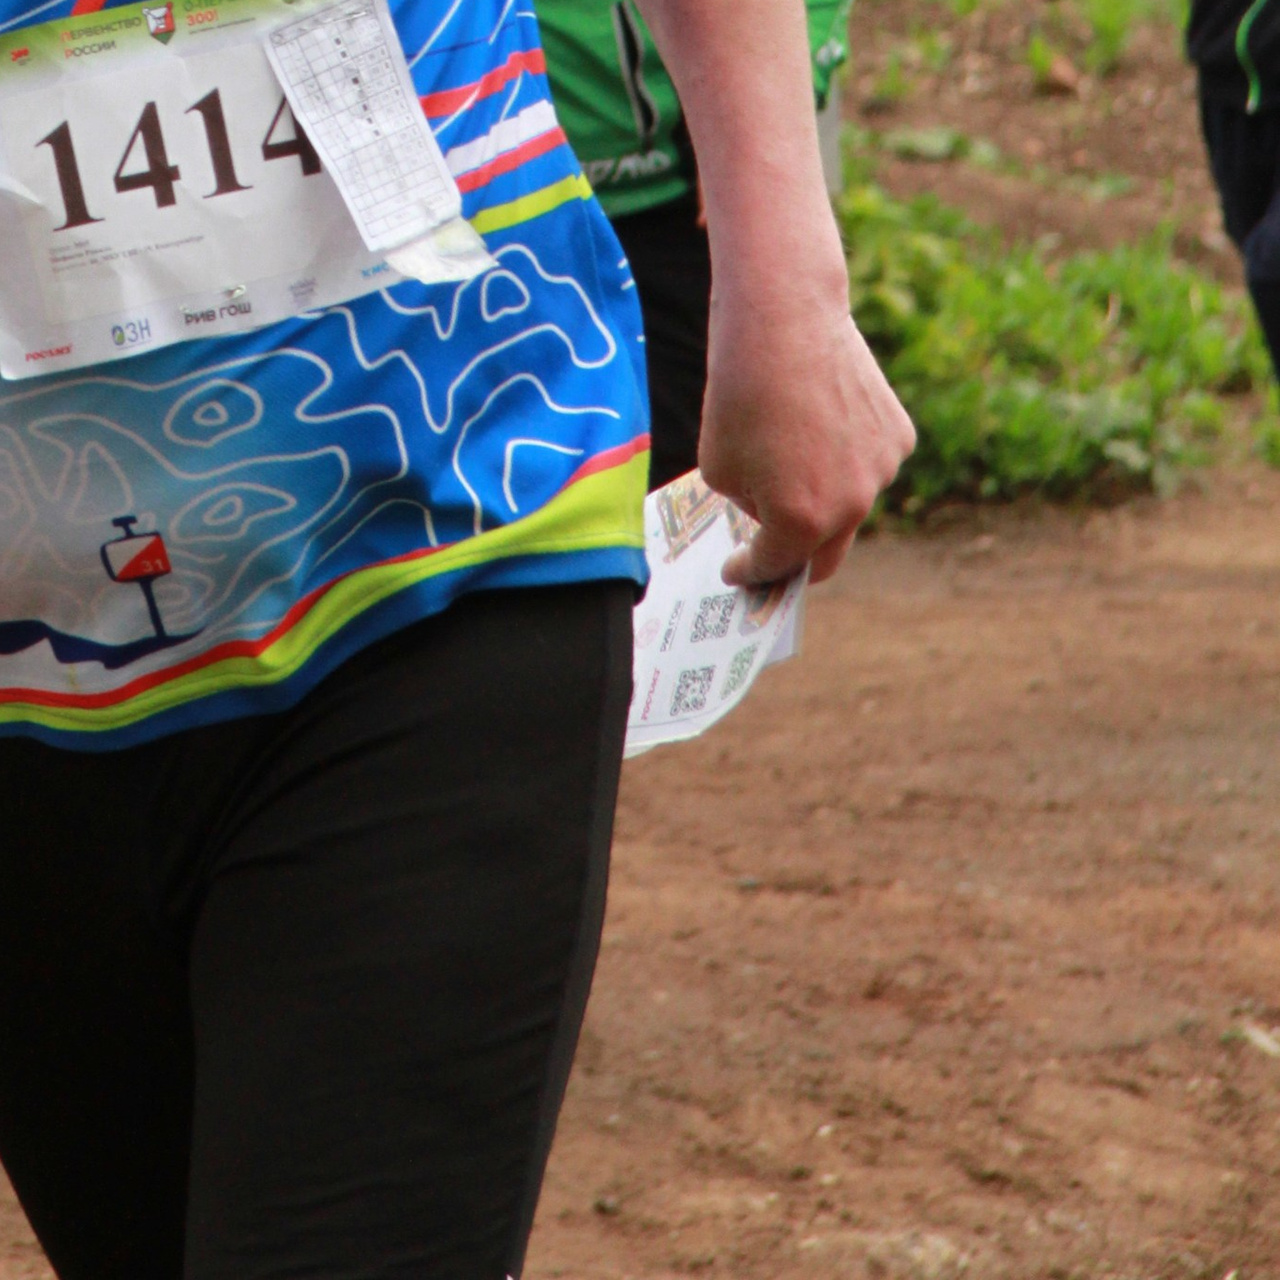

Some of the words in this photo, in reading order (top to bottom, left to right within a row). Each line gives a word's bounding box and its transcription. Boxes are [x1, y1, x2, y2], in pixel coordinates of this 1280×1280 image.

[60, 15, 143, 43] ПЕРВЕНСТВО
[64, 39, 117, 59] РОССИИ
[34, 86, 323, 232] 1414
